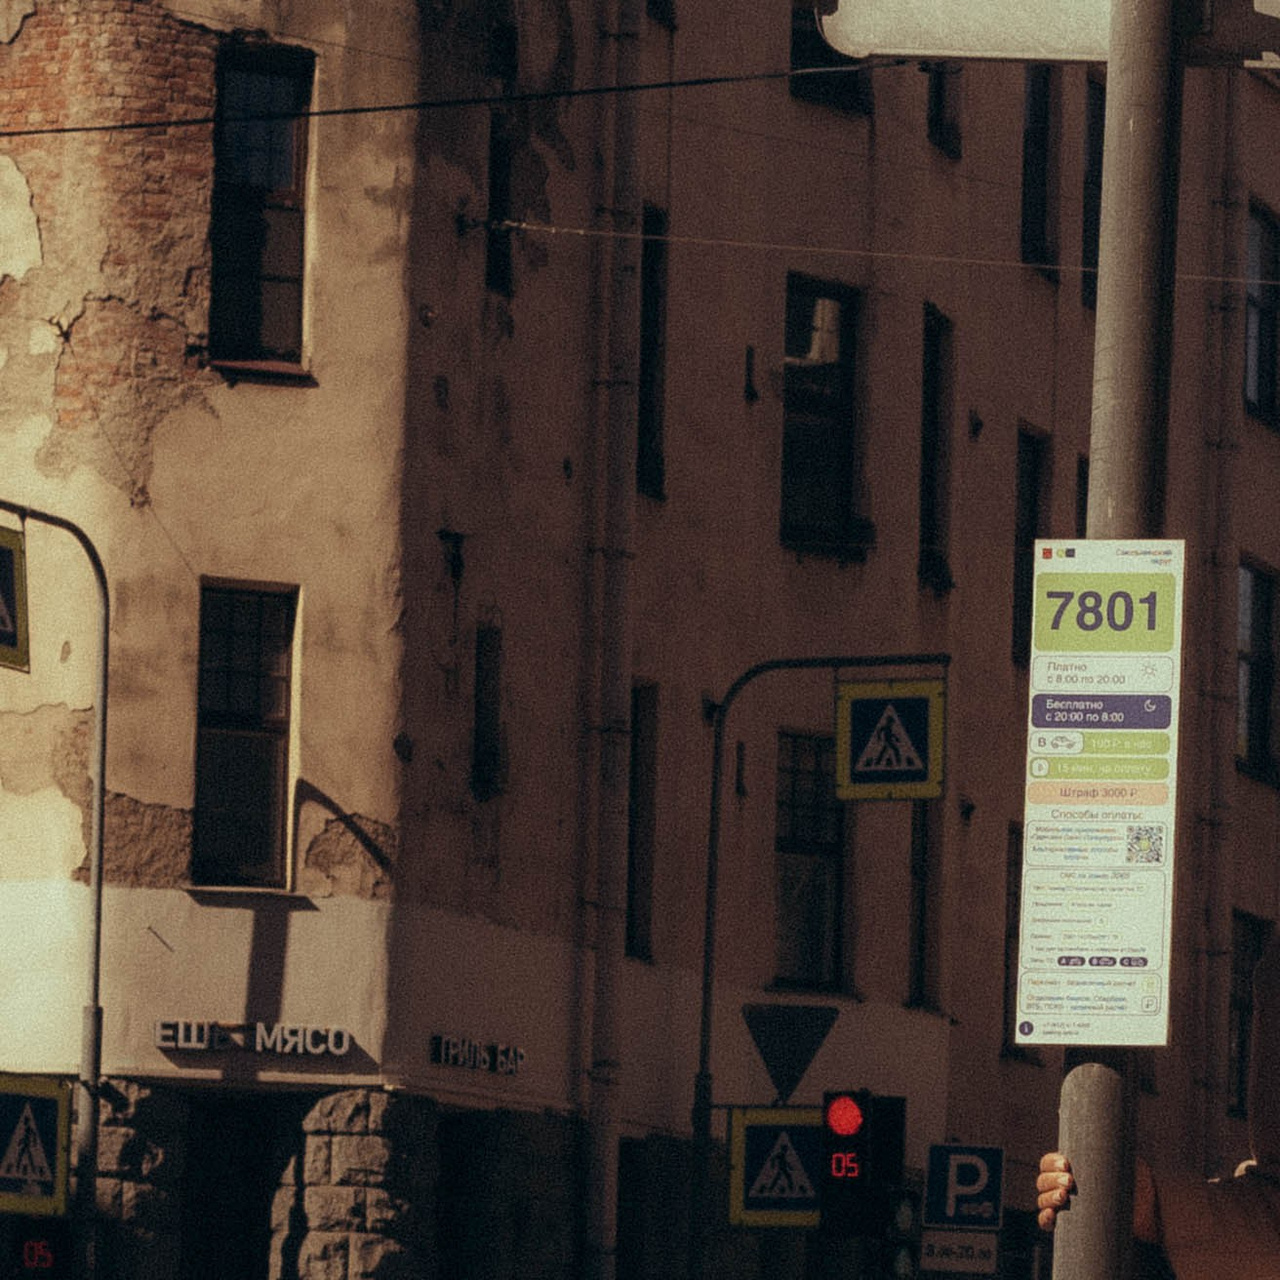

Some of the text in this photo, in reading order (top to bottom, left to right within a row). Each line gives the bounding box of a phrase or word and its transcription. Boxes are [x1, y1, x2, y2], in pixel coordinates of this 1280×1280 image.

[1046, 590, 1158, 632] 7801
[1047, 661, 1087, 672] Платно
[1046, 699, 1104, 710] Бесплатно
[1045, 711, 1124, 723] с 20:00 по 8:00
[1059, 787, 1099, 800] Штраф
[1101, 787, 1127, 798] 3000
[1051, 808, 1099, 819] Способы
[255, 1021, 351, 1056] МЯСО
[831, 1152, 859, 1178] 05
[23, 1240, 54, 1268] 05
